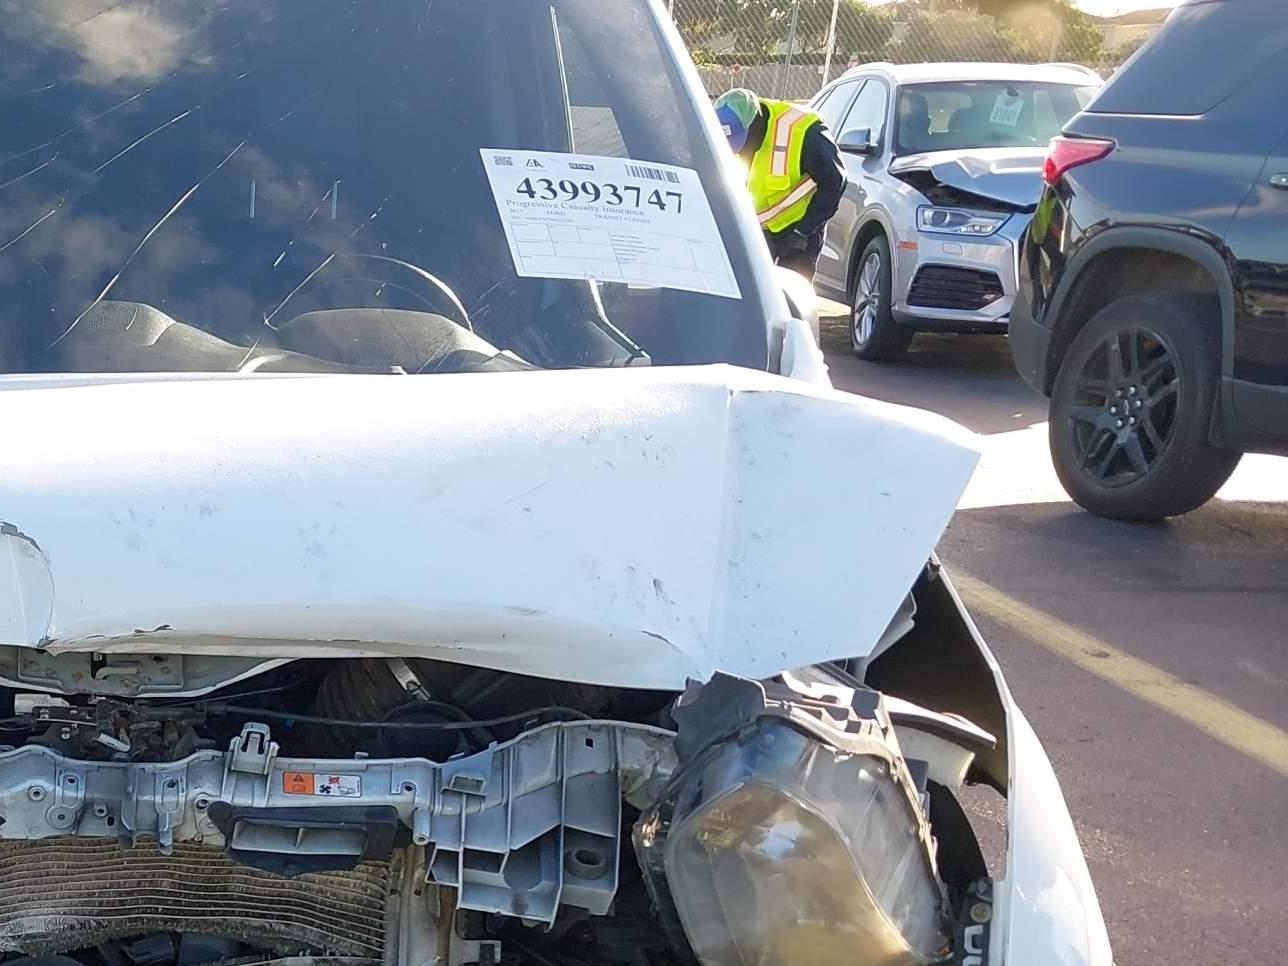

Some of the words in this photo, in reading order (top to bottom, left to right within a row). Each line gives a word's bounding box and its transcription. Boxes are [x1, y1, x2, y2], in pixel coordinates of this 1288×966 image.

[506, 199, 559, 210] Progressive
[562, 202, 599, 213] Casualty
[601, 205, 645, 216] Insurance
[516, 177, 683, 214] 43993747
